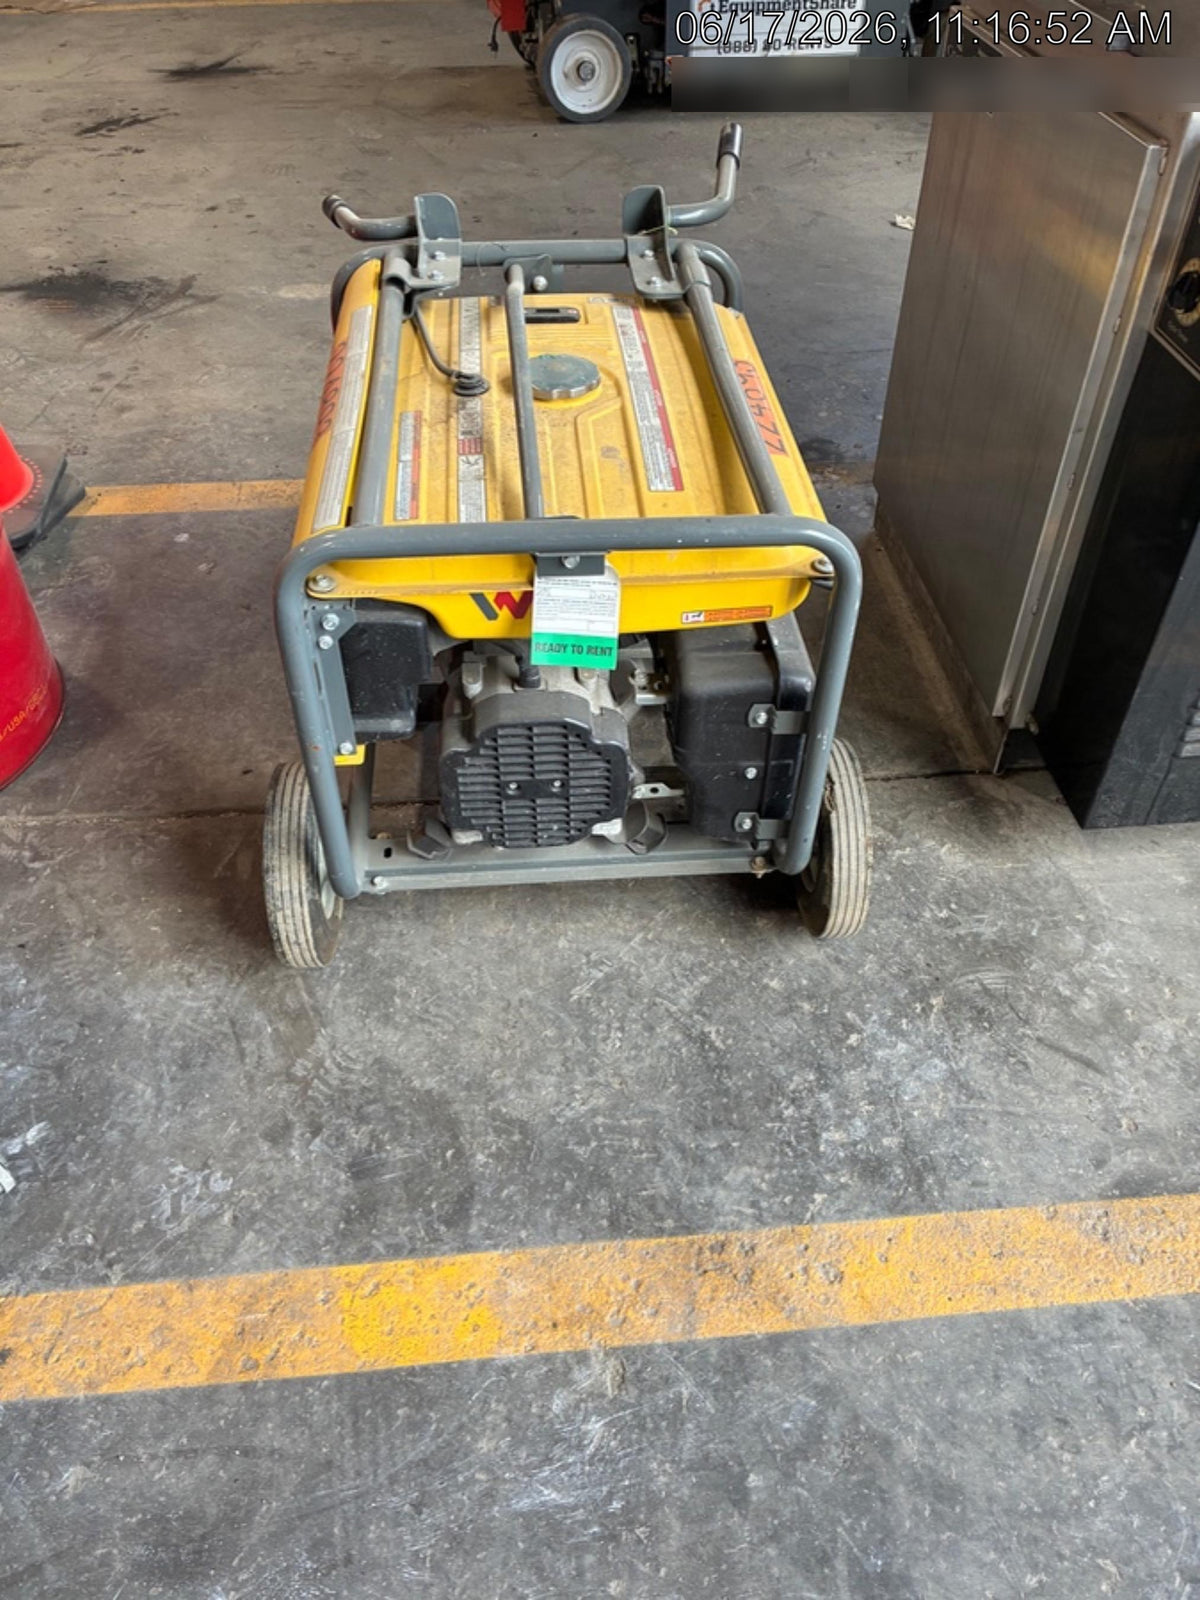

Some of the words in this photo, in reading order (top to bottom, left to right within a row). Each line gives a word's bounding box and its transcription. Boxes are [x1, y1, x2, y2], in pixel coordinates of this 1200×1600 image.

[535, 641, 568, 654] READY
[570, 643, 584, 655] TO
[586, 645, 613, 657] RENT
